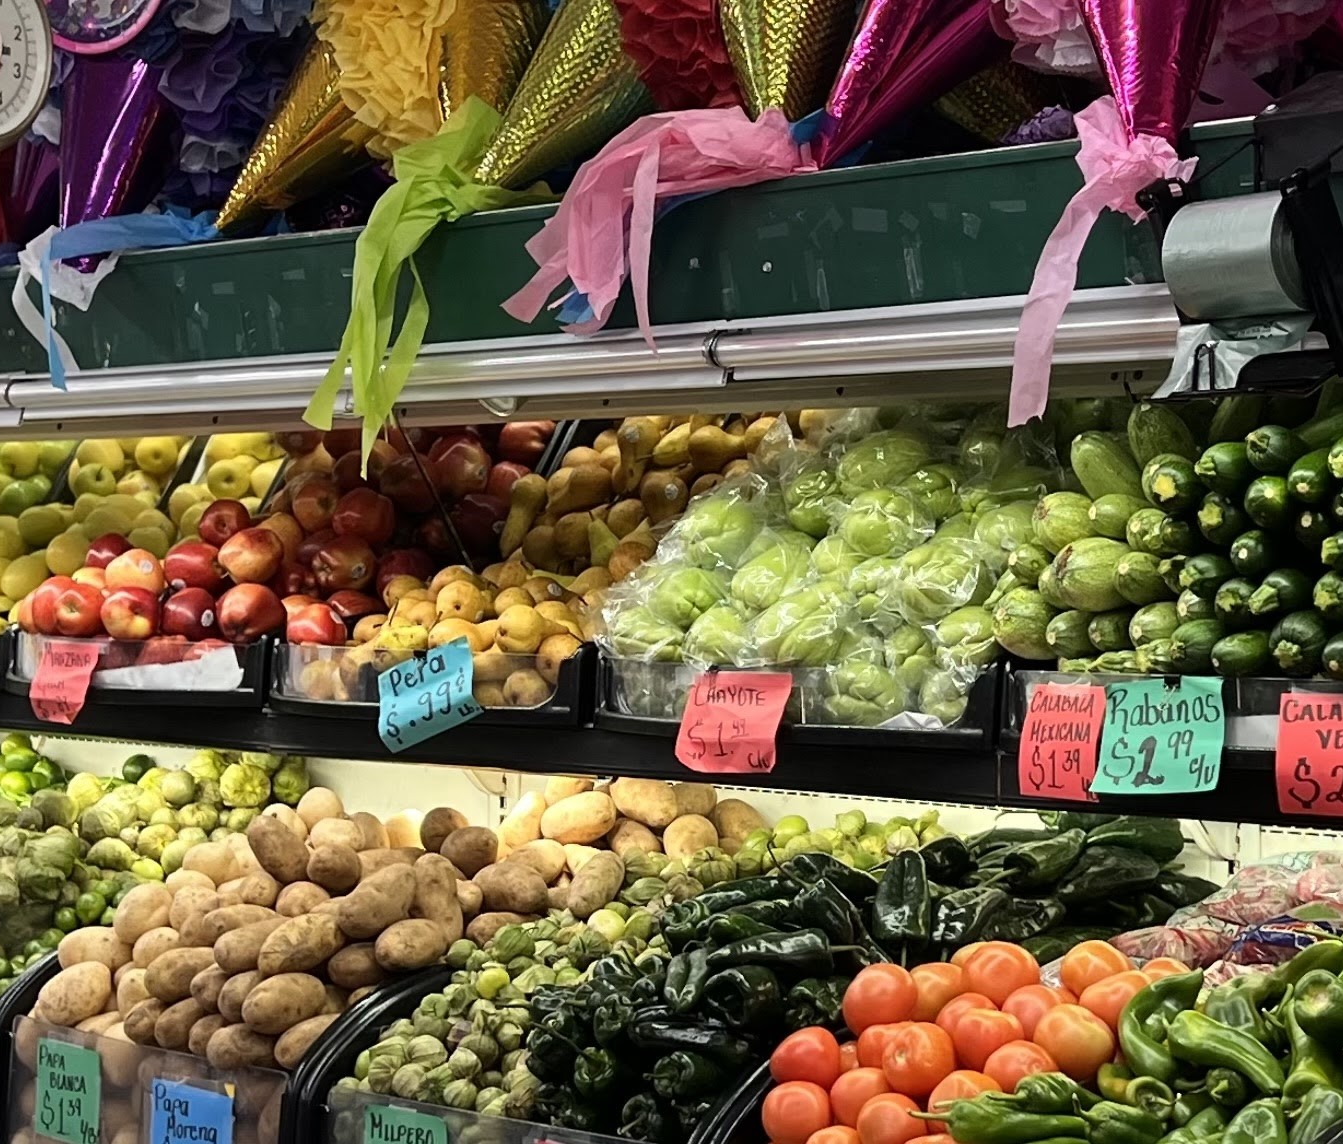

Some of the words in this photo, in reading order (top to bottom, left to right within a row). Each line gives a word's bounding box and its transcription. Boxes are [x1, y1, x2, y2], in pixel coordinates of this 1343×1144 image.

[14, 26, 22, 41] 2
[13, 63, 22, 79] 3
[389, 651, 447, 697] Pera
[693, 681, 768, 707] CHAYOTE
[1029, 690, 1096, 718] CALABAZA
[1029, 718, 1092, 744] MEXICANA
[38, 1043, 66, 1072] PAPA
[49, 1070, 87, 1095] BLANCA
